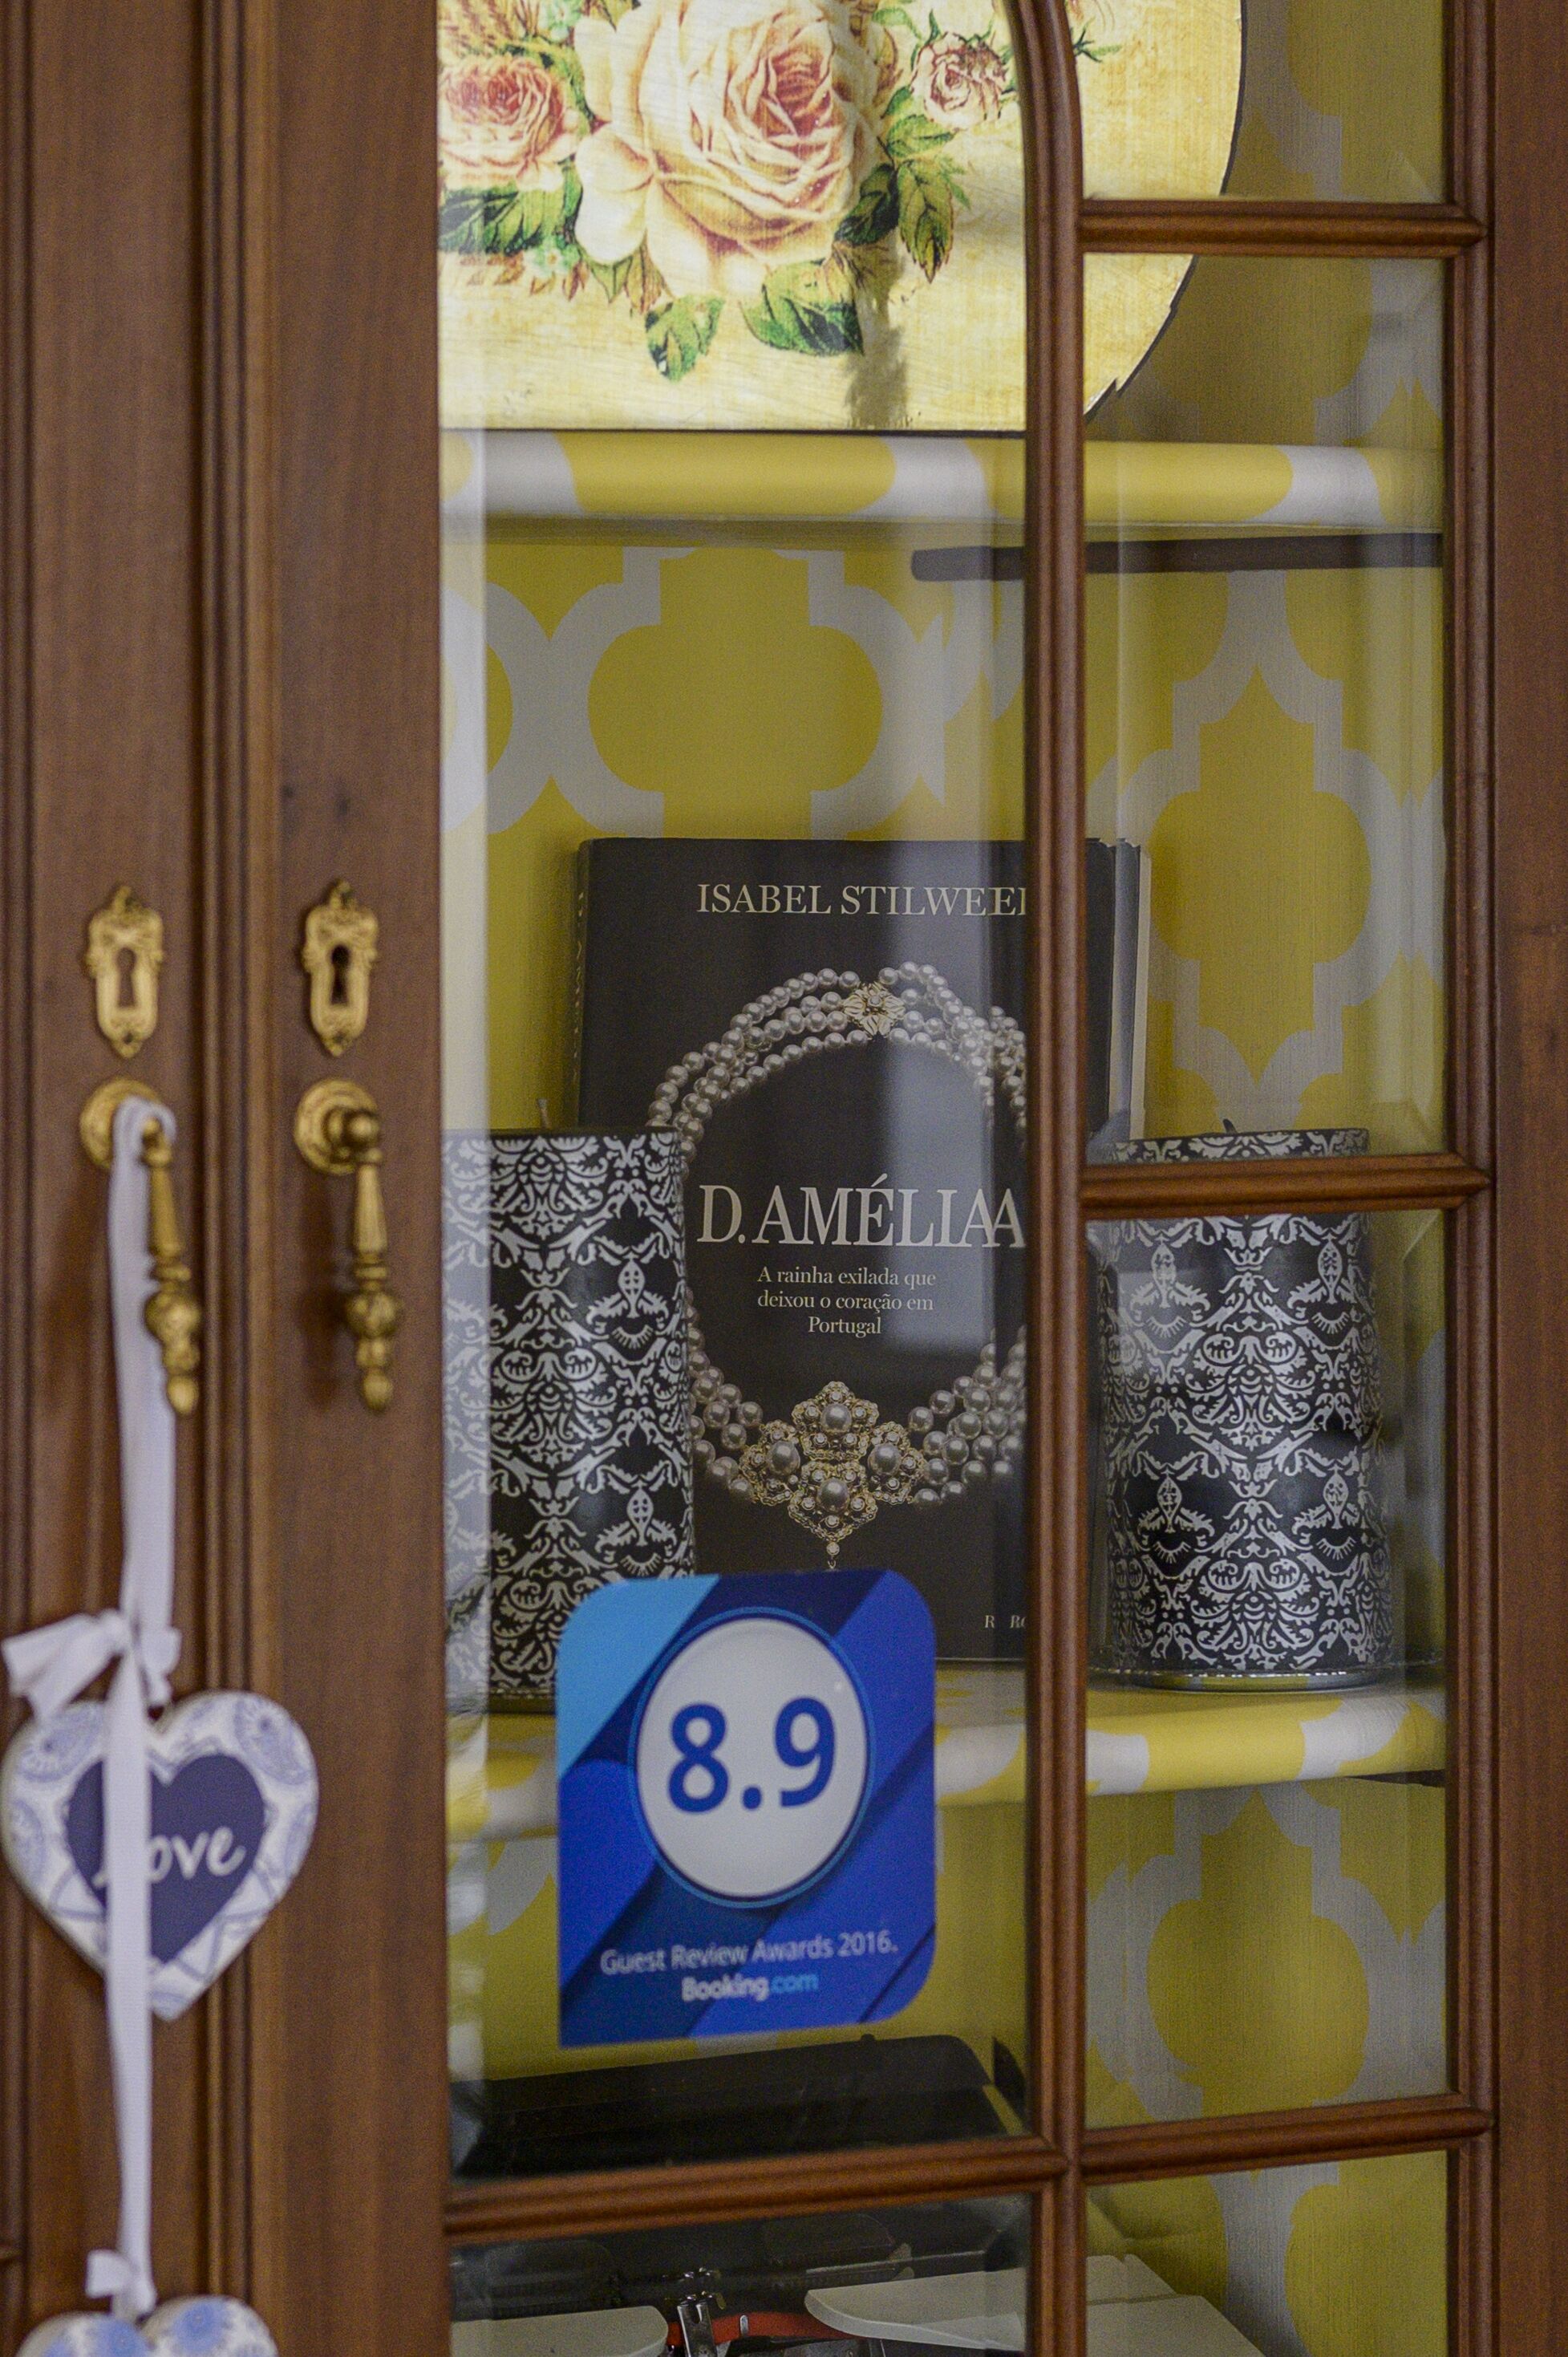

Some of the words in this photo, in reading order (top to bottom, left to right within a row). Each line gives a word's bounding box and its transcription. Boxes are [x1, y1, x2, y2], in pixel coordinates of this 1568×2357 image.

[696, 883, 831, 914] ISABEL
[757, 1267, 771, 1284] A
[777, 1267, 833, 1284] rainha
[838, 1268, 899, 1286] exilada
[904, 1272, 936, 1292] que
[758, 1290, 815, 1309] deixou
[820, 1296, 831, 1309] o
[836, 1294, 902, 1314] coração
[907, 1298, 934, 1311] em
[808, 1316, 883, 1338] Portugal
[667, 1697, 836, 1813] 8.9
[92, 1827, 246, 1888] ove
[600, 1947, 667, 1975] Guest
[671, 1941, 750, 1970] Review
[752, 1936, 833, 1962] Awards
